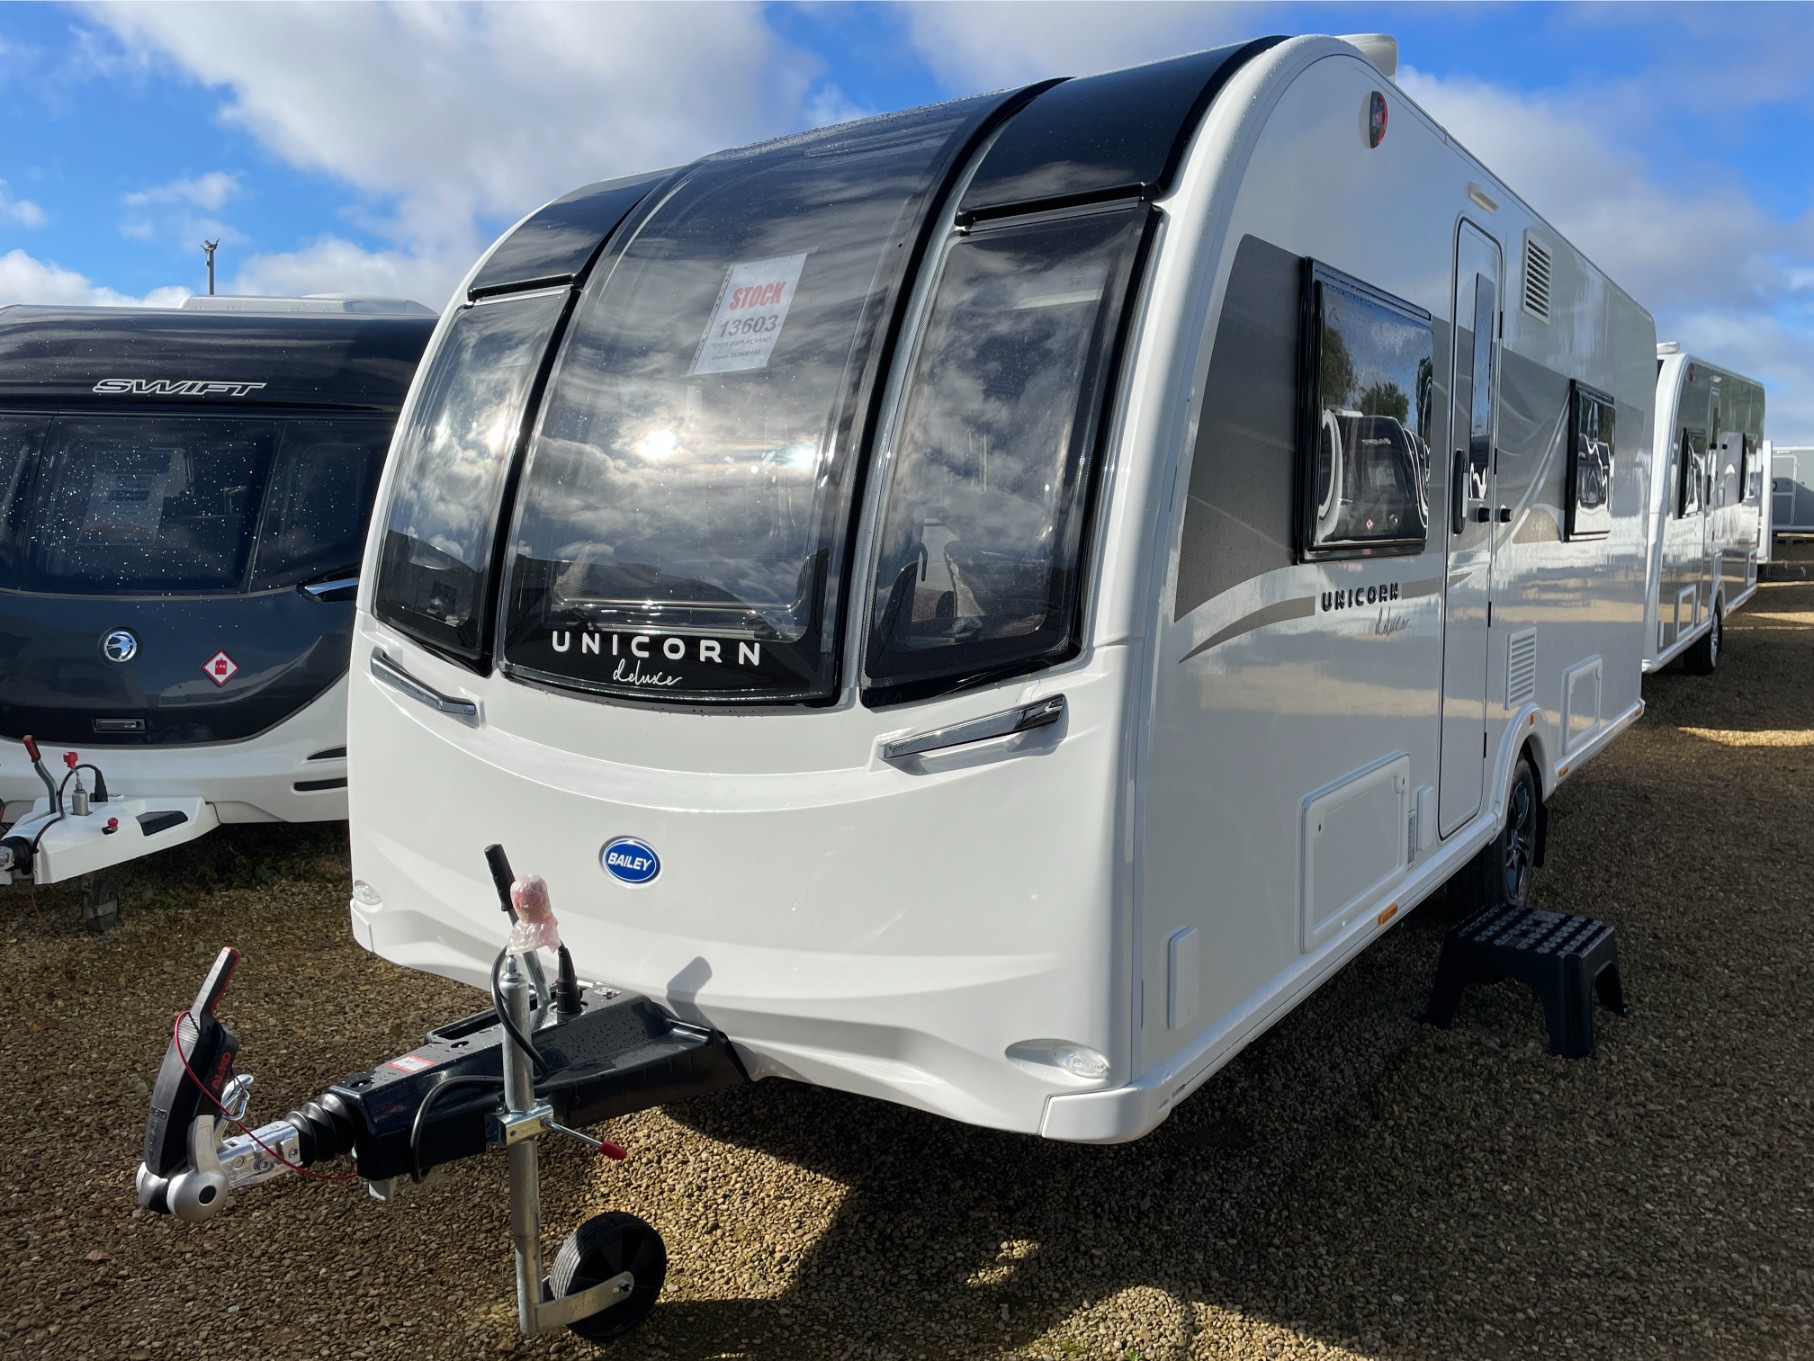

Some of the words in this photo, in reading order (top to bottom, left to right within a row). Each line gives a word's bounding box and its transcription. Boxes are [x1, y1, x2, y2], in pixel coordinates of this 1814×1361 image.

[729, 281, 787, 311] STOCK
[719, 314, 779, 338] 13603
[92, 378, 268, 397] SWIFT
[1320, 582, 1399, 612] UNICORN
[551, 630, 761, 667] UNICORN
[612, 658, 683, 687] deluxe
[607, 852, 653, 872] BAILEY
